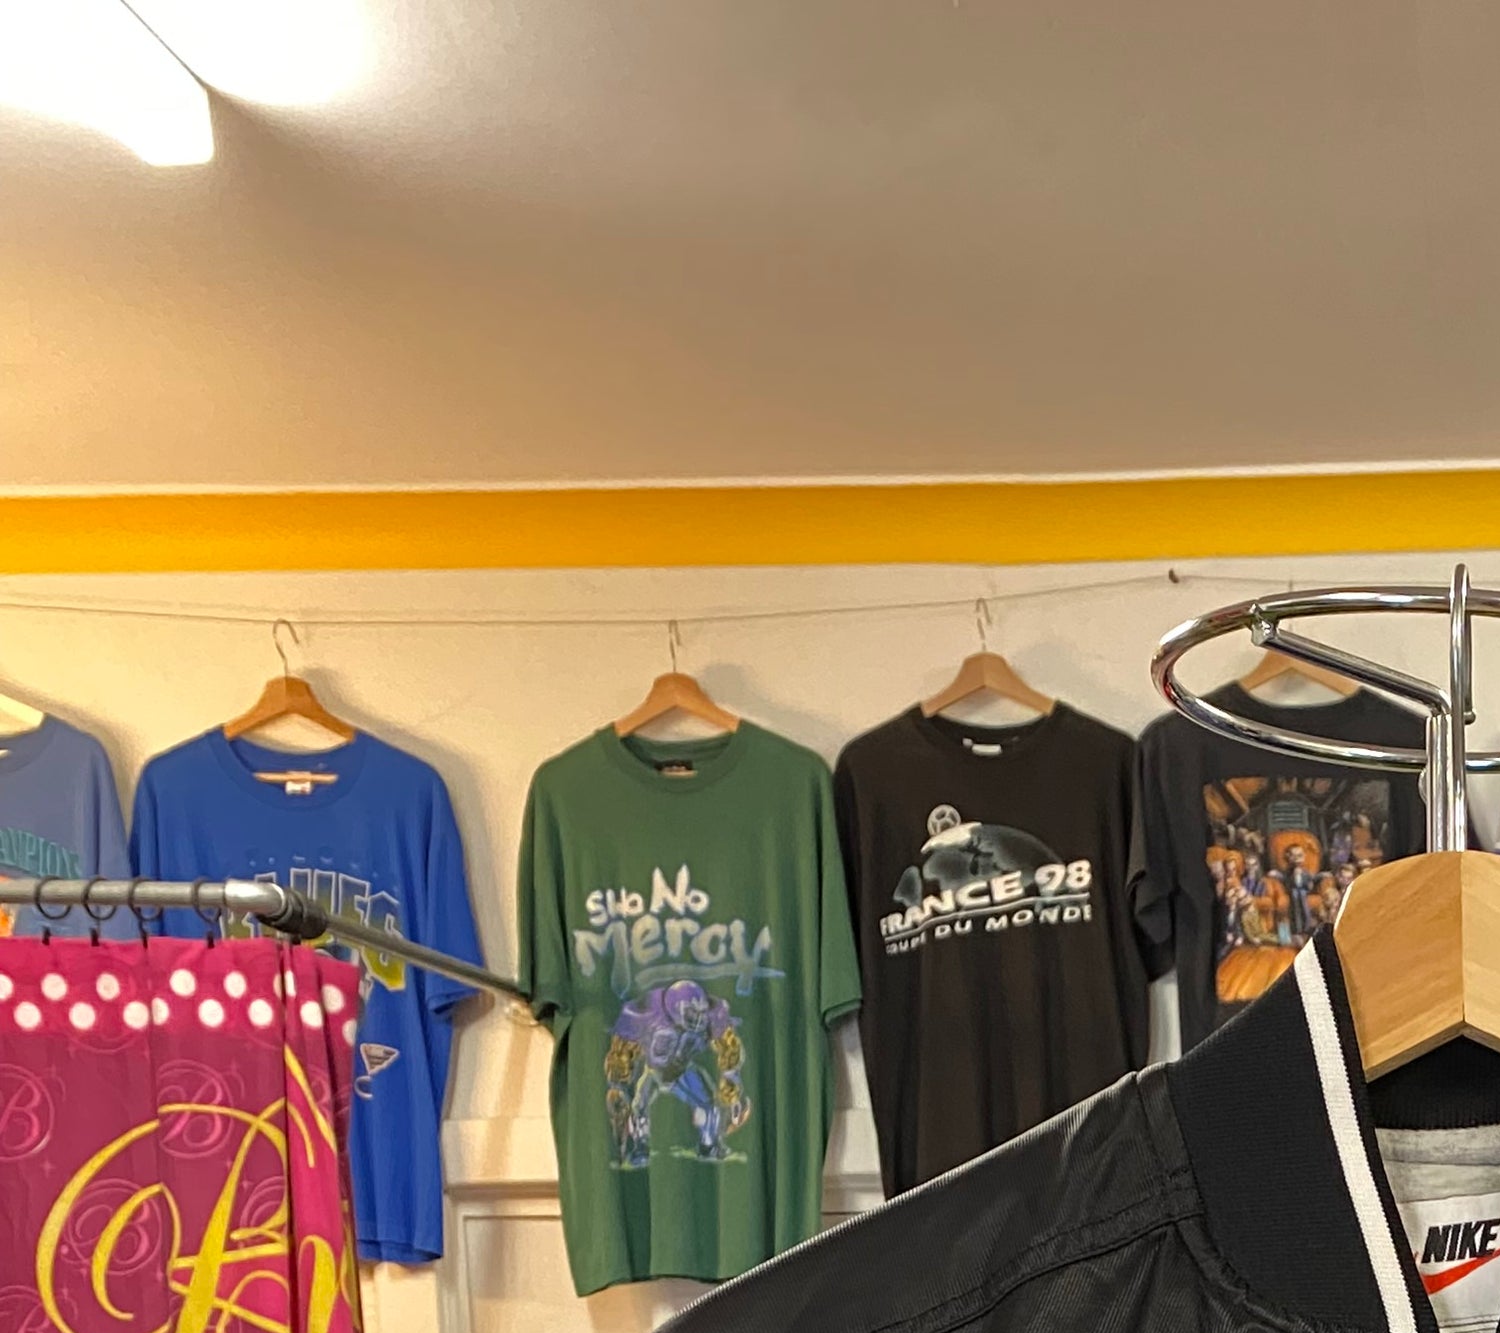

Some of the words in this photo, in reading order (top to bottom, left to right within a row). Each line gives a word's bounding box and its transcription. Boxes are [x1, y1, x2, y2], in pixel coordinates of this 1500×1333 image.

[650, 864, 710, 915] No
[880, 870, 1025, 936] FRANCE
[1034, 859, 1093, 895] 98
[934, 918, 973, 939] DU
[572, 914, 785, 999] Mercy
[1421, 1218, 1500, 1263] NIKE
